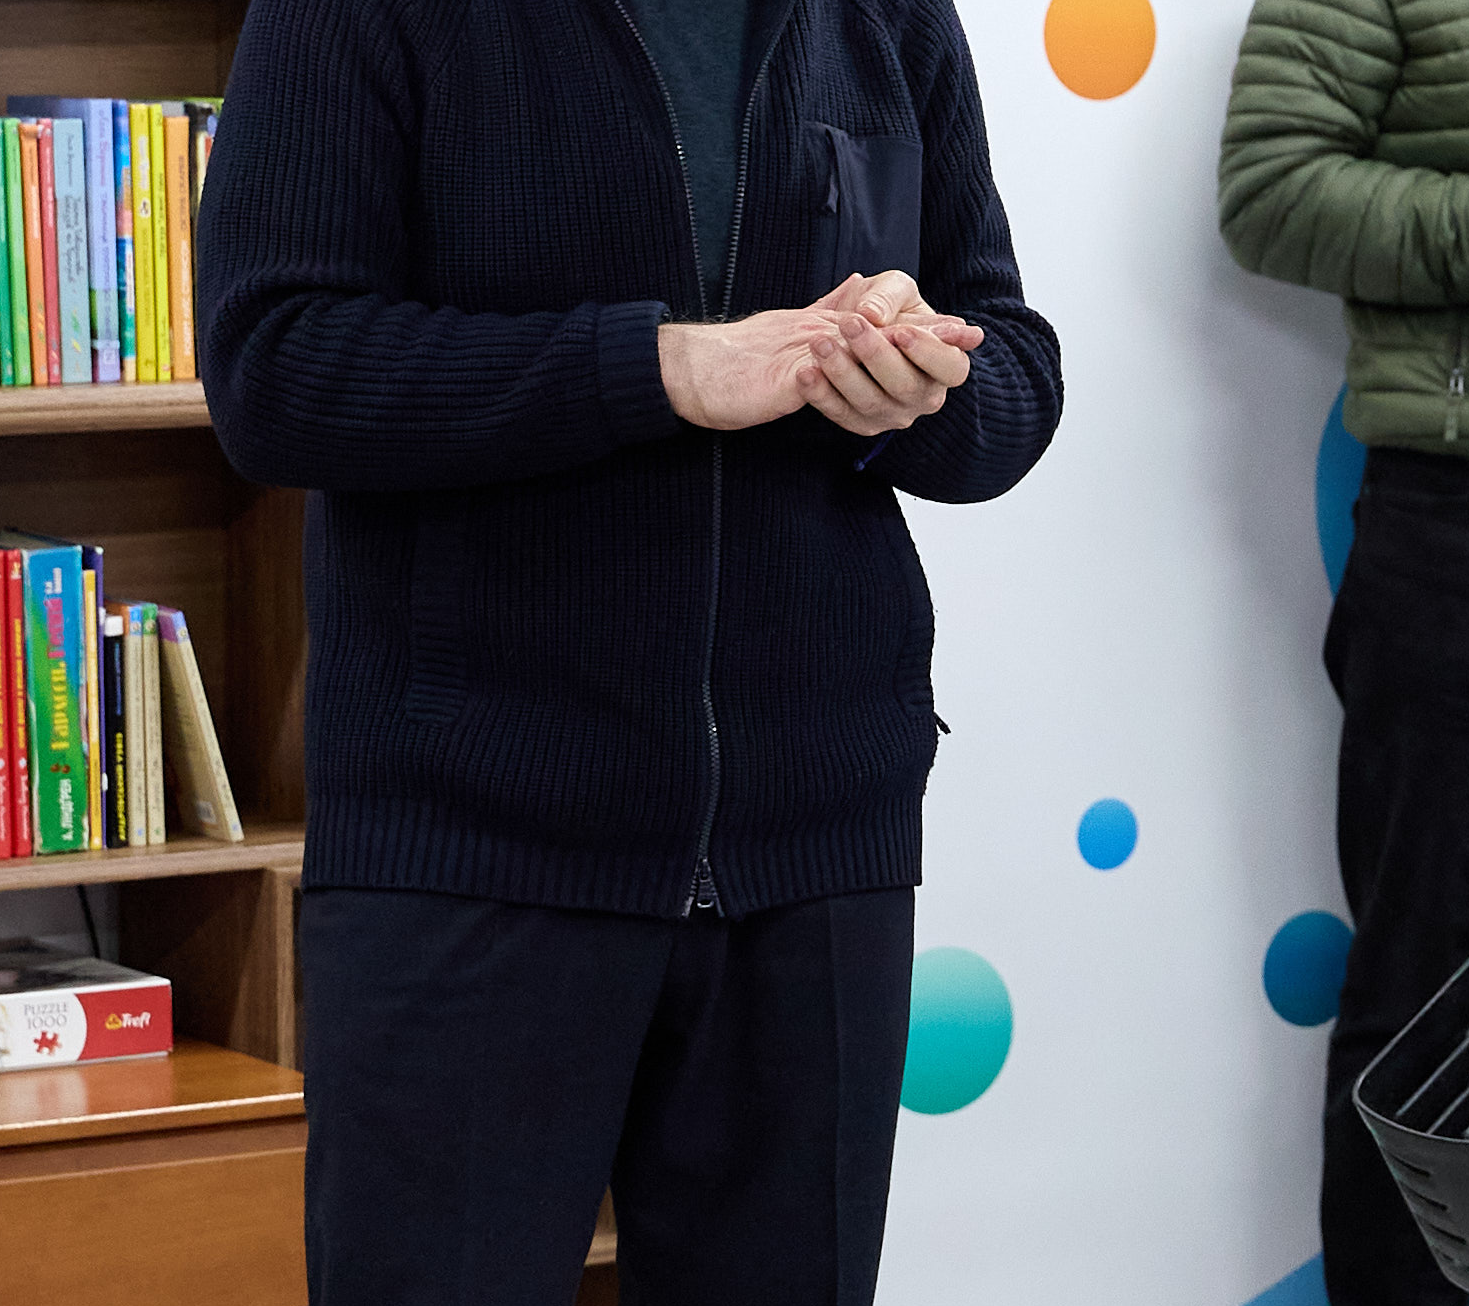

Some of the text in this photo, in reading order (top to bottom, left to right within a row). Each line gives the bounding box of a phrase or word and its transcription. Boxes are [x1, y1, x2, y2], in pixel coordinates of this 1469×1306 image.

[23, 1002, 69, 1016] PUZZLE
[27, 1014, 68, 1029] 1000
[121, 1011, 151, 1029] Trefl
